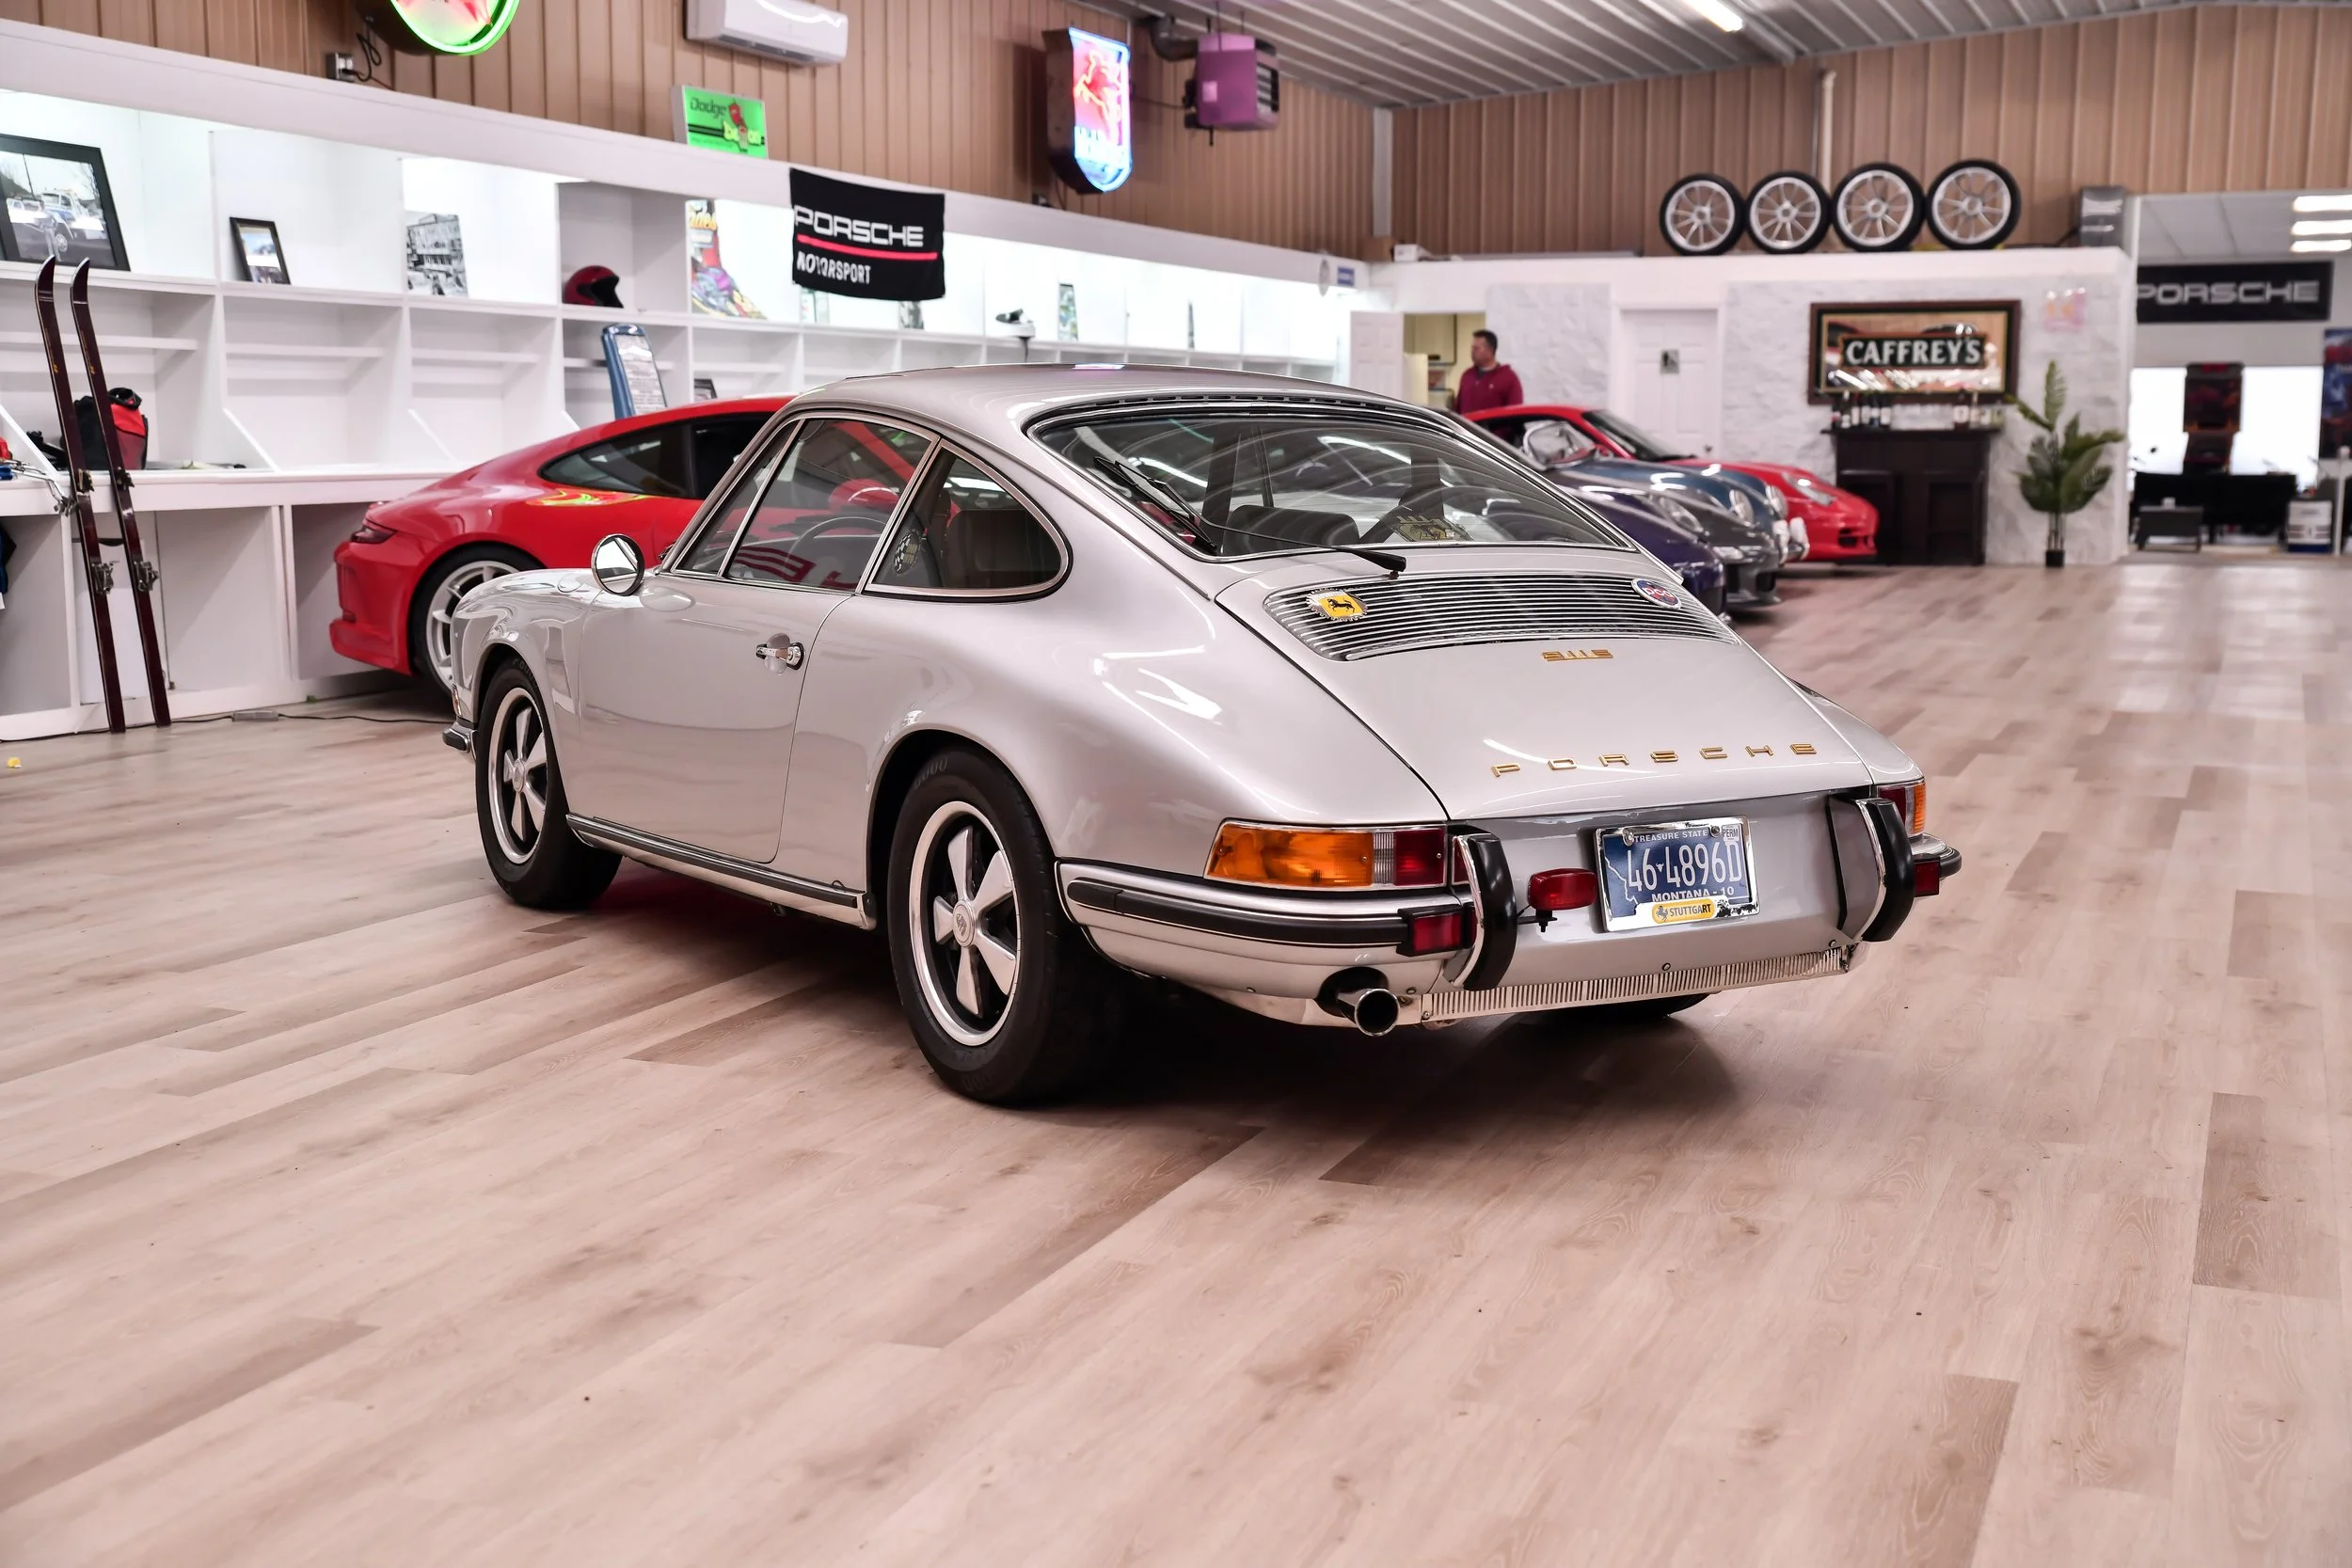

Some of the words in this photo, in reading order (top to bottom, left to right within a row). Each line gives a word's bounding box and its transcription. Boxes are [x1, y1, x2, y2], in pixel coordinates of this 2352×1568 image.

[690, 97, 726, 119] Dodge
[794, 205, 924, 247] PORSCHE
[2137, 280, 2320, 305] PORSCHE
[1846, 339, 1982, 365] CAFFREY'S
[1490, 742, 1818, 778] PORSCHE
[1634, 832, 1679, 843] TREASURE
[1683, 829, 1708, 838] STATE
[1723, 828, 1740, 838] PERM
[1651, 888, 1711, 902] MONTANA
[1721, 886, 1735, 896] 10
[1669, 903, 1711, 917] STUTTGART
